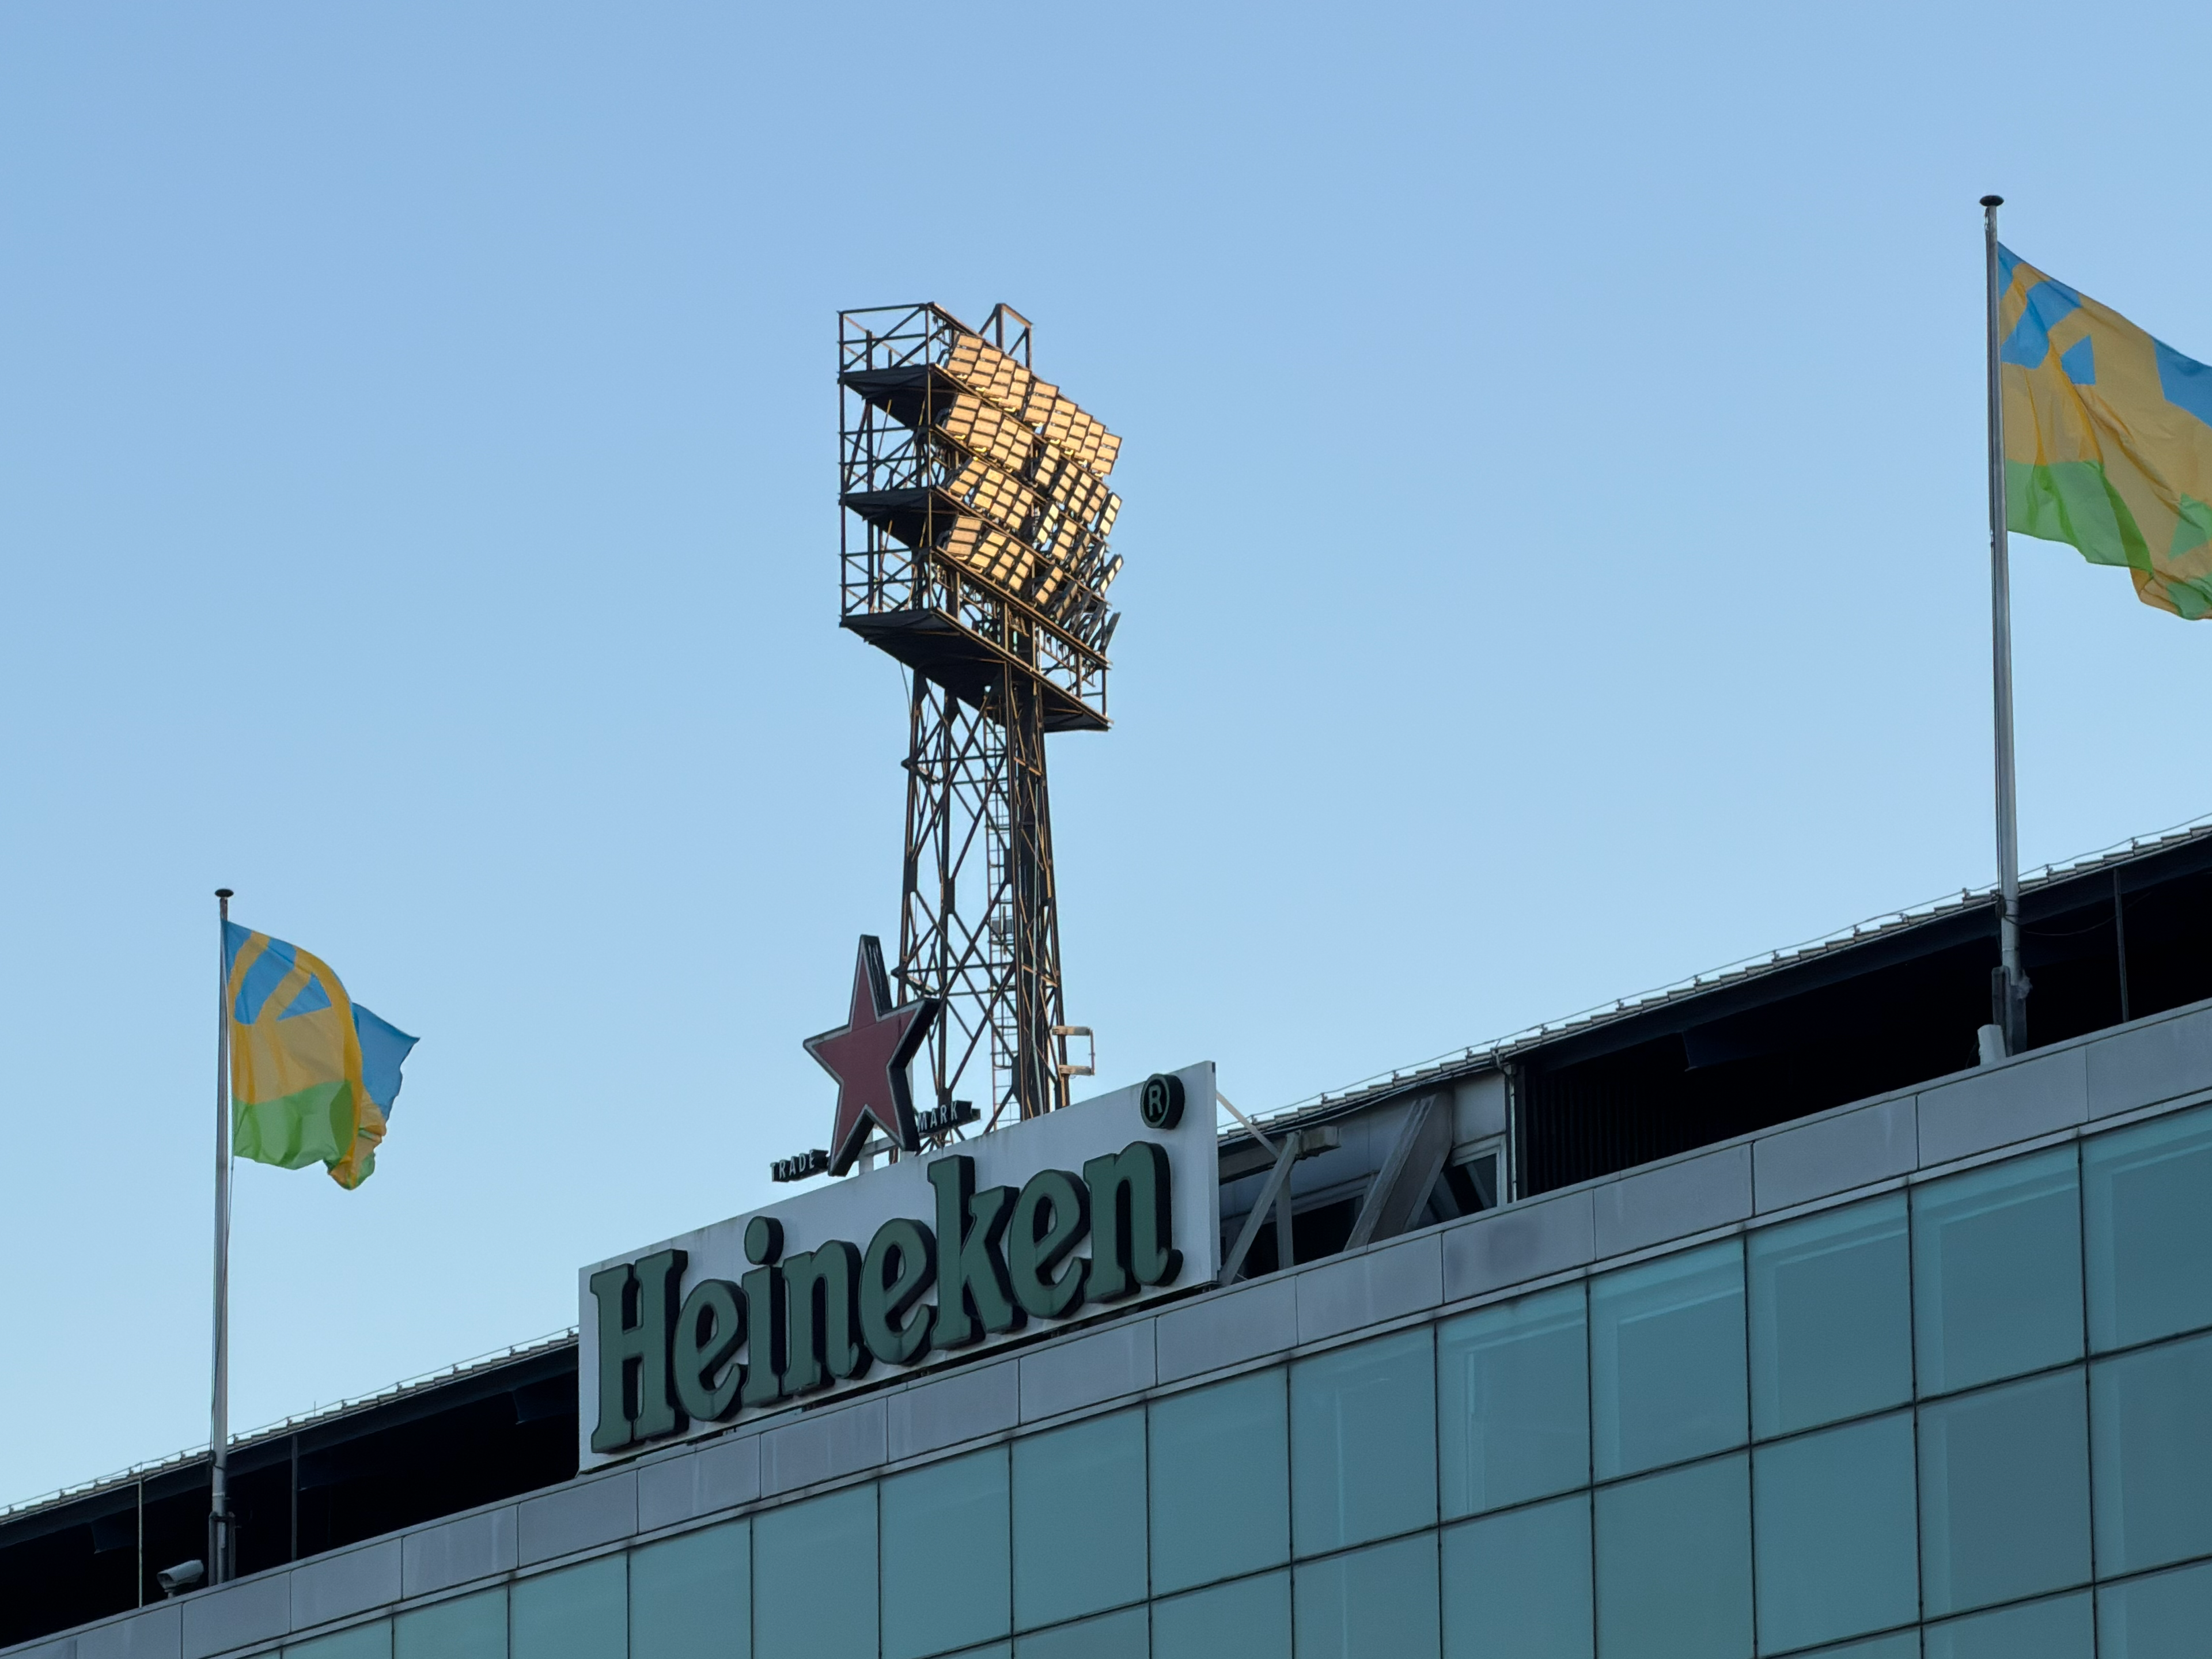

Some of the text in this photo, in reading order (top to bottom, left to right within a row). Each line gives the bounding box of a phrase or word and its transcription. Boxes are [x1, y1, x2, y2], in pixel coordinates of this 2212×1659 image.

[770, 1101, 958, 1181] TRADE MARK
[590, 1141, 1183, 1453] Heineken
